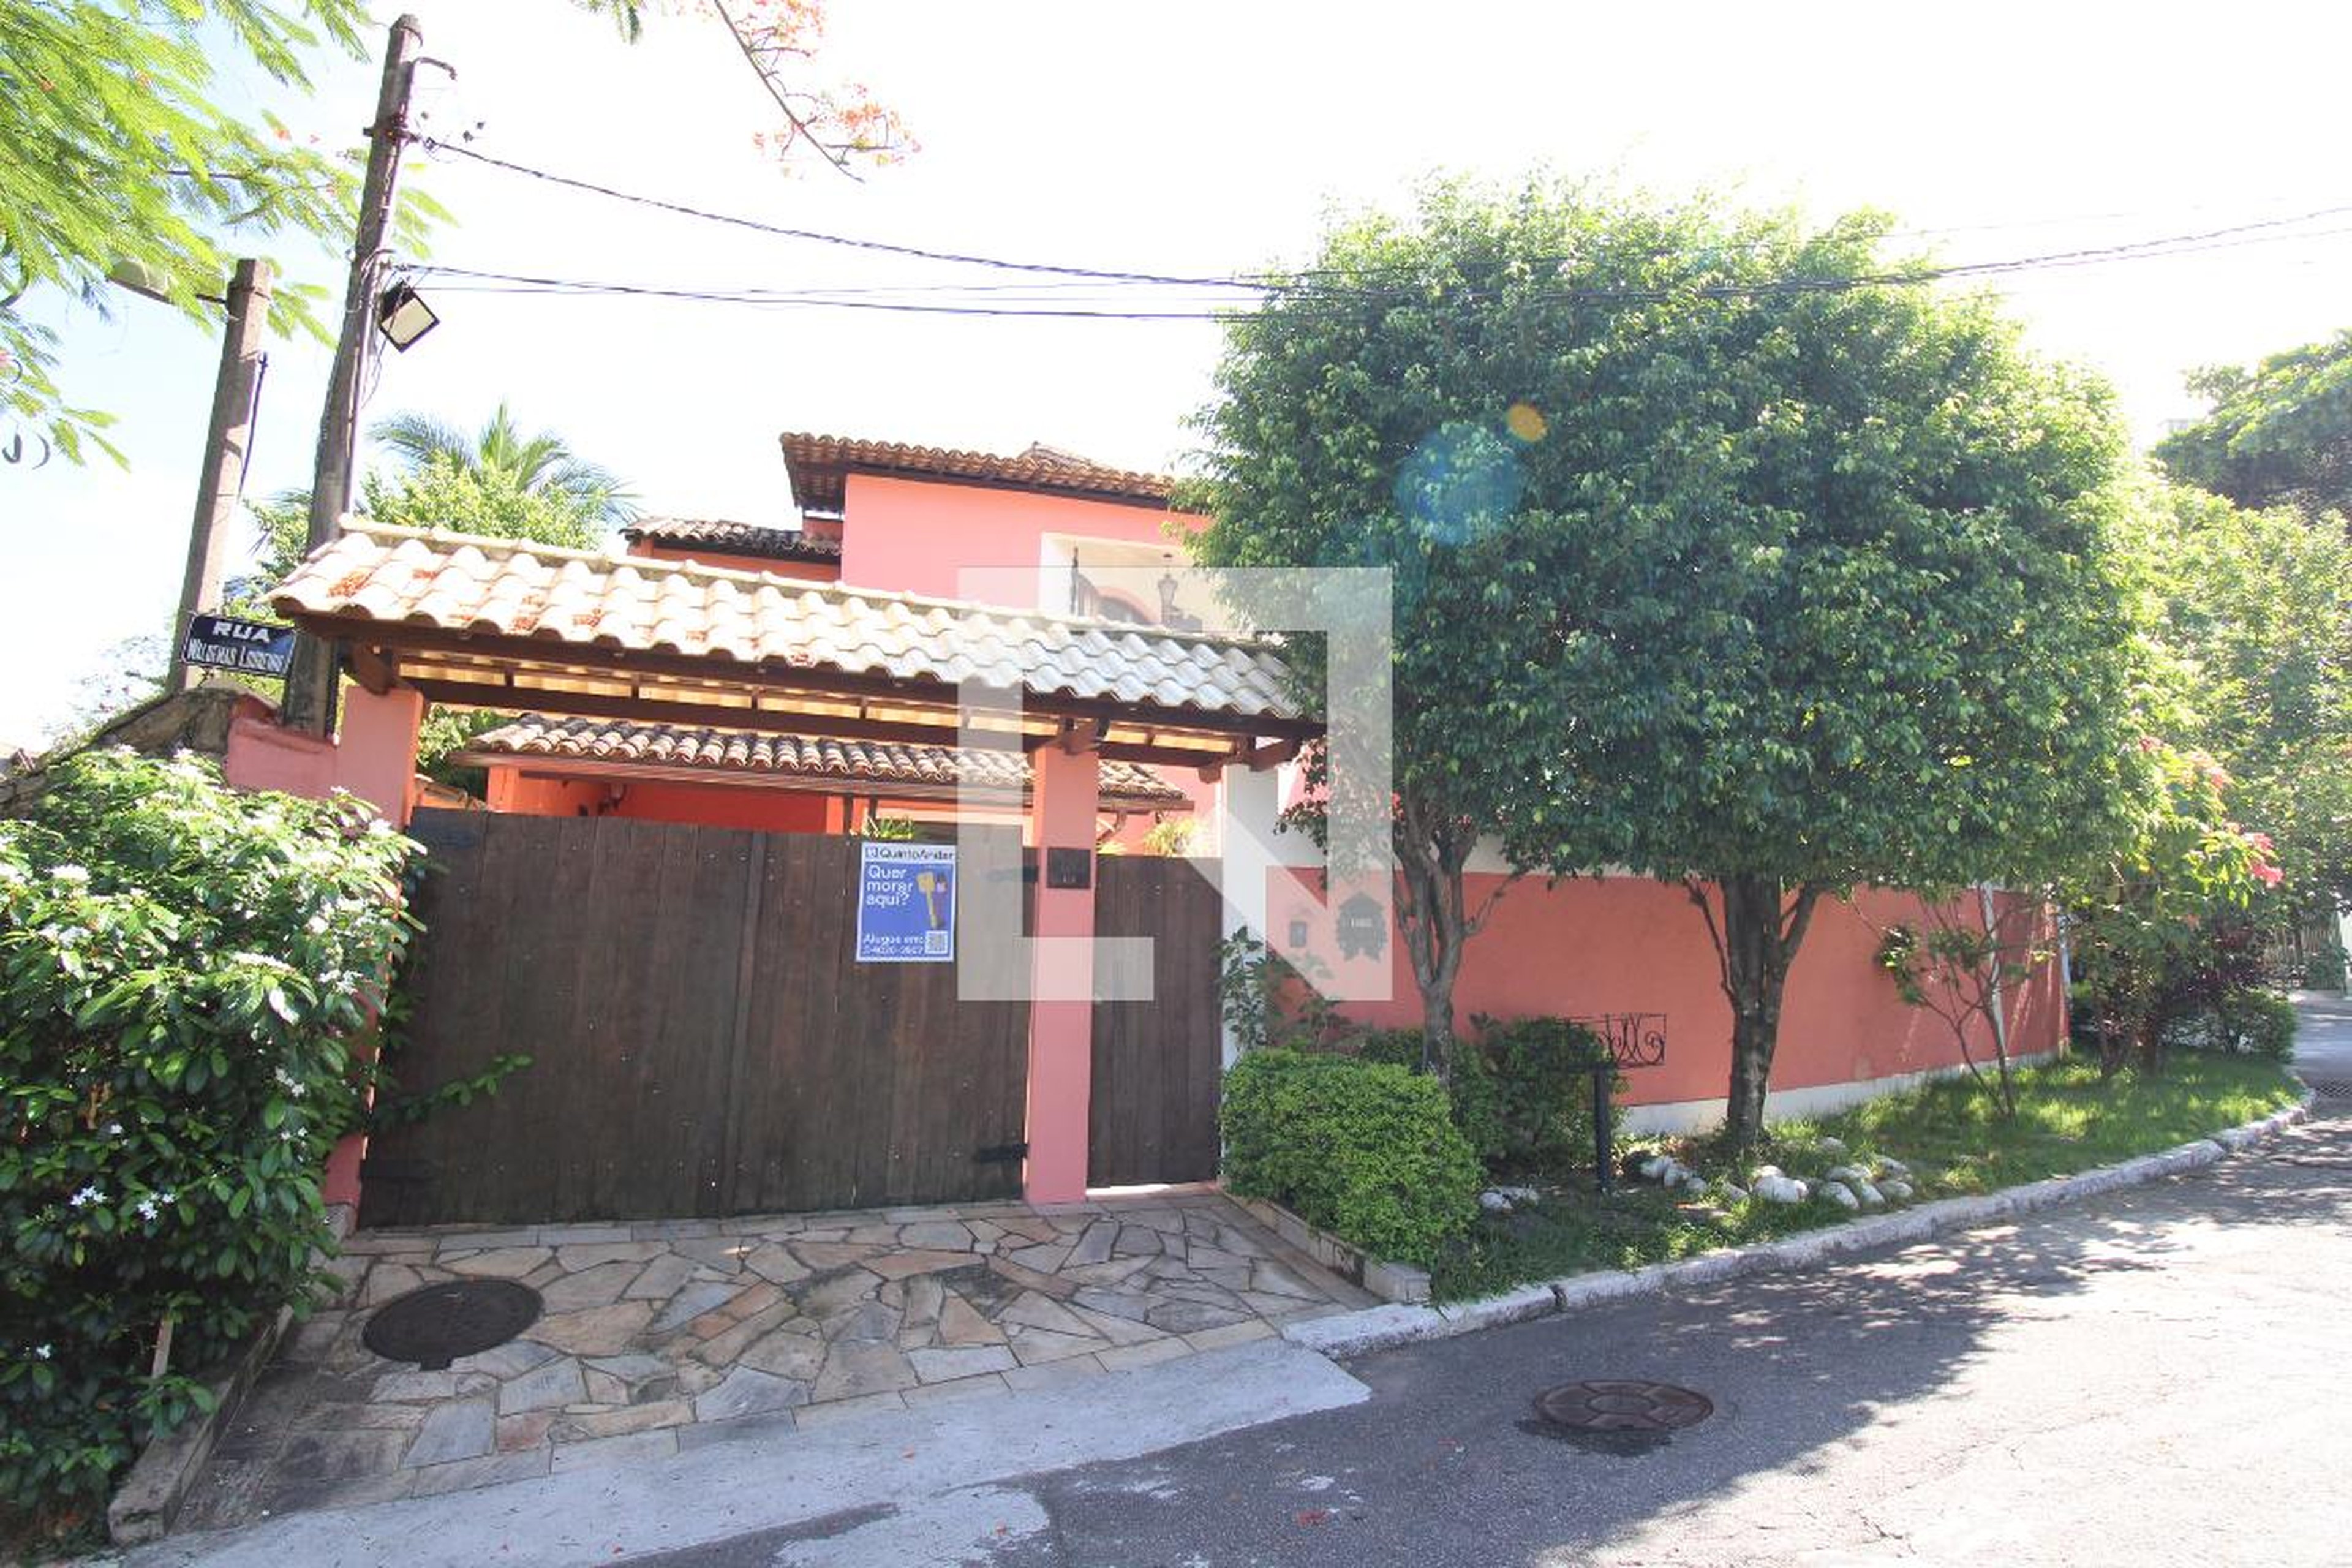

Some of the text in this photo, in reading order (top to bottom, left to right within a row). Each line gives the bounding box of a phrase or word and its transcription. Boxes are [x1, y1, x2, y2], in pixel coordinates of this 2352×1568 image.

[213, 621, 271, 643] RUA
[868, 865, 907, 879] Quer
[867, 881, 913, 892] morar
[866, 892, 910, 908] aqui?
